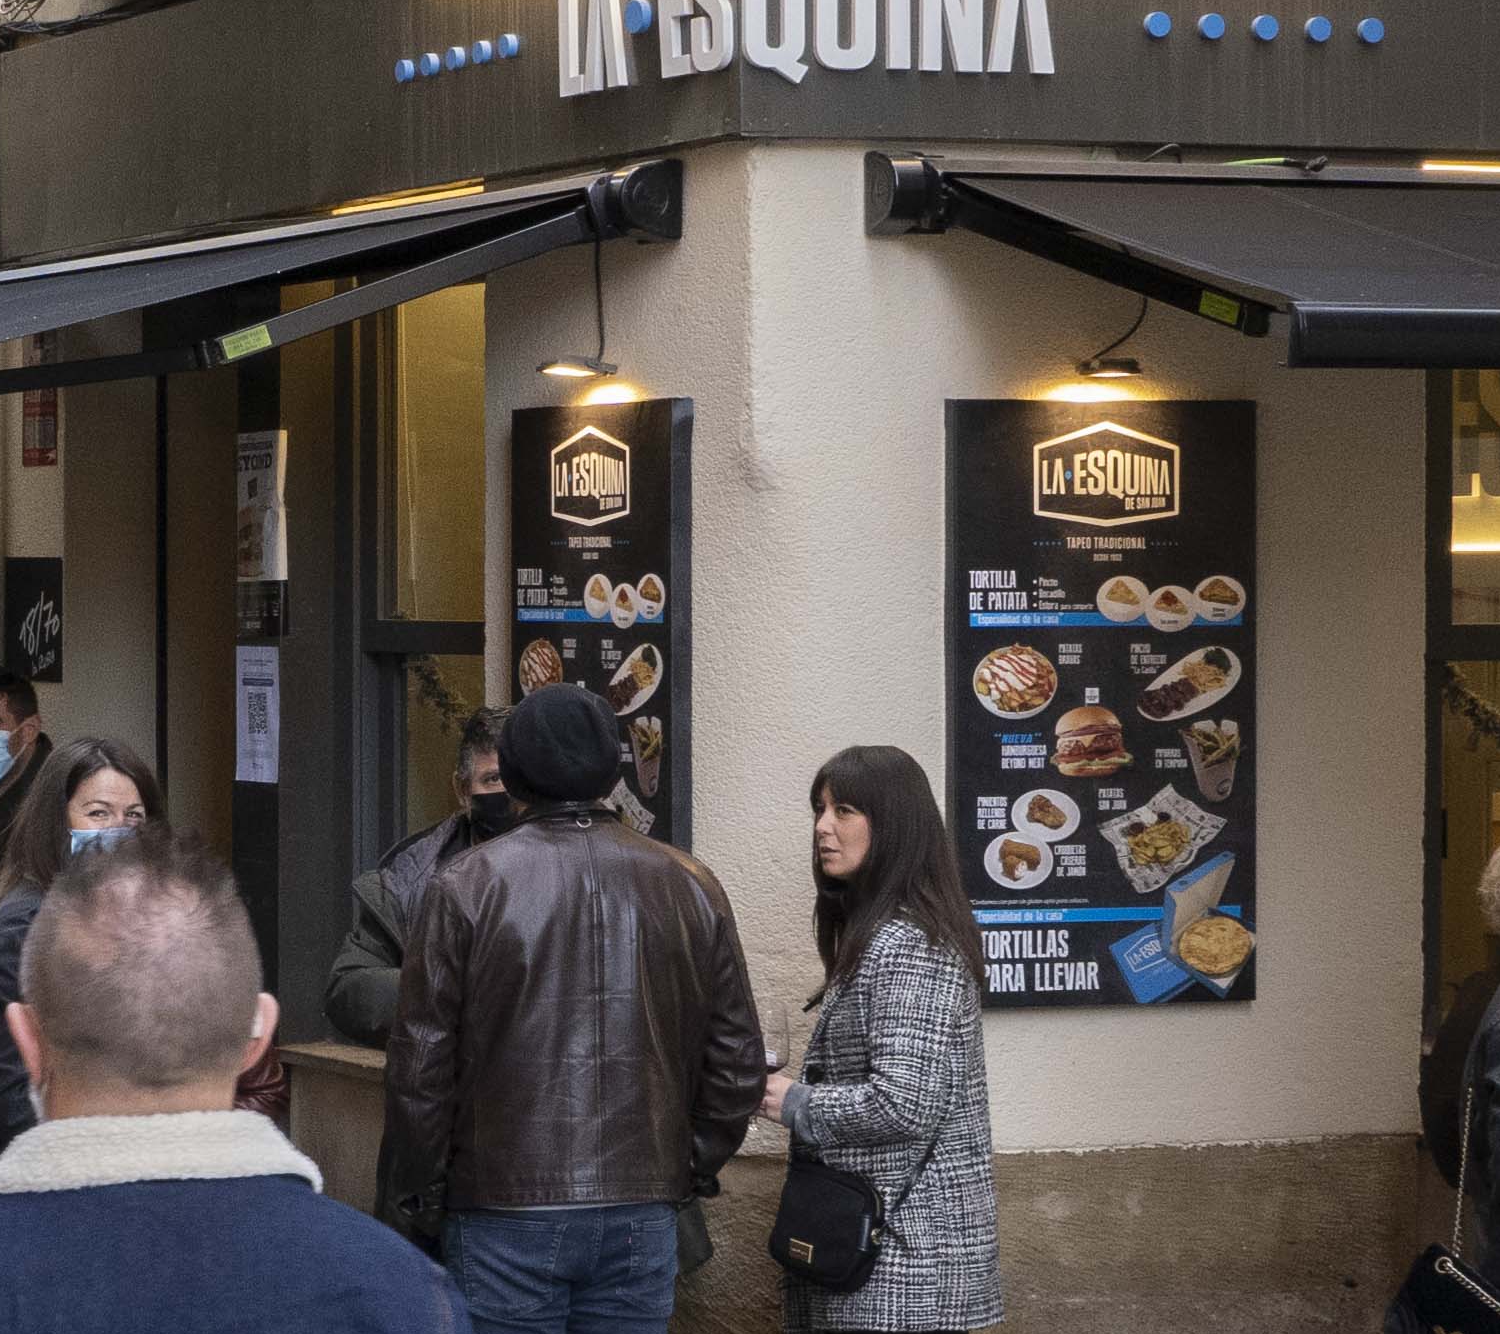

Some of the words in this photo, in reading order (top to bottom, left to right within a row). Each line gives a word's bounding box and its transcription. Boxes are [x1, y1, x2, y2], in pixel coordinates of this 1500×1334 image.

[555, 462, 567, 498] LA
[571, 452, 625, 500] ESQUINA
[1041, 458, 1066, 496] LA
[1073, 449, 1171, 500] ESQUINA
[1066, 536, 1091, 549] TAPEO
[1093, 536, 1147, 550] TRADICIONAL
[969, 570, 1017, 589] TORTILLA
[969, 592, 983, 611] DE
[988, 591, 1028, 611] PATATA
[1034, 961, 1100, 991] LLEVAR
